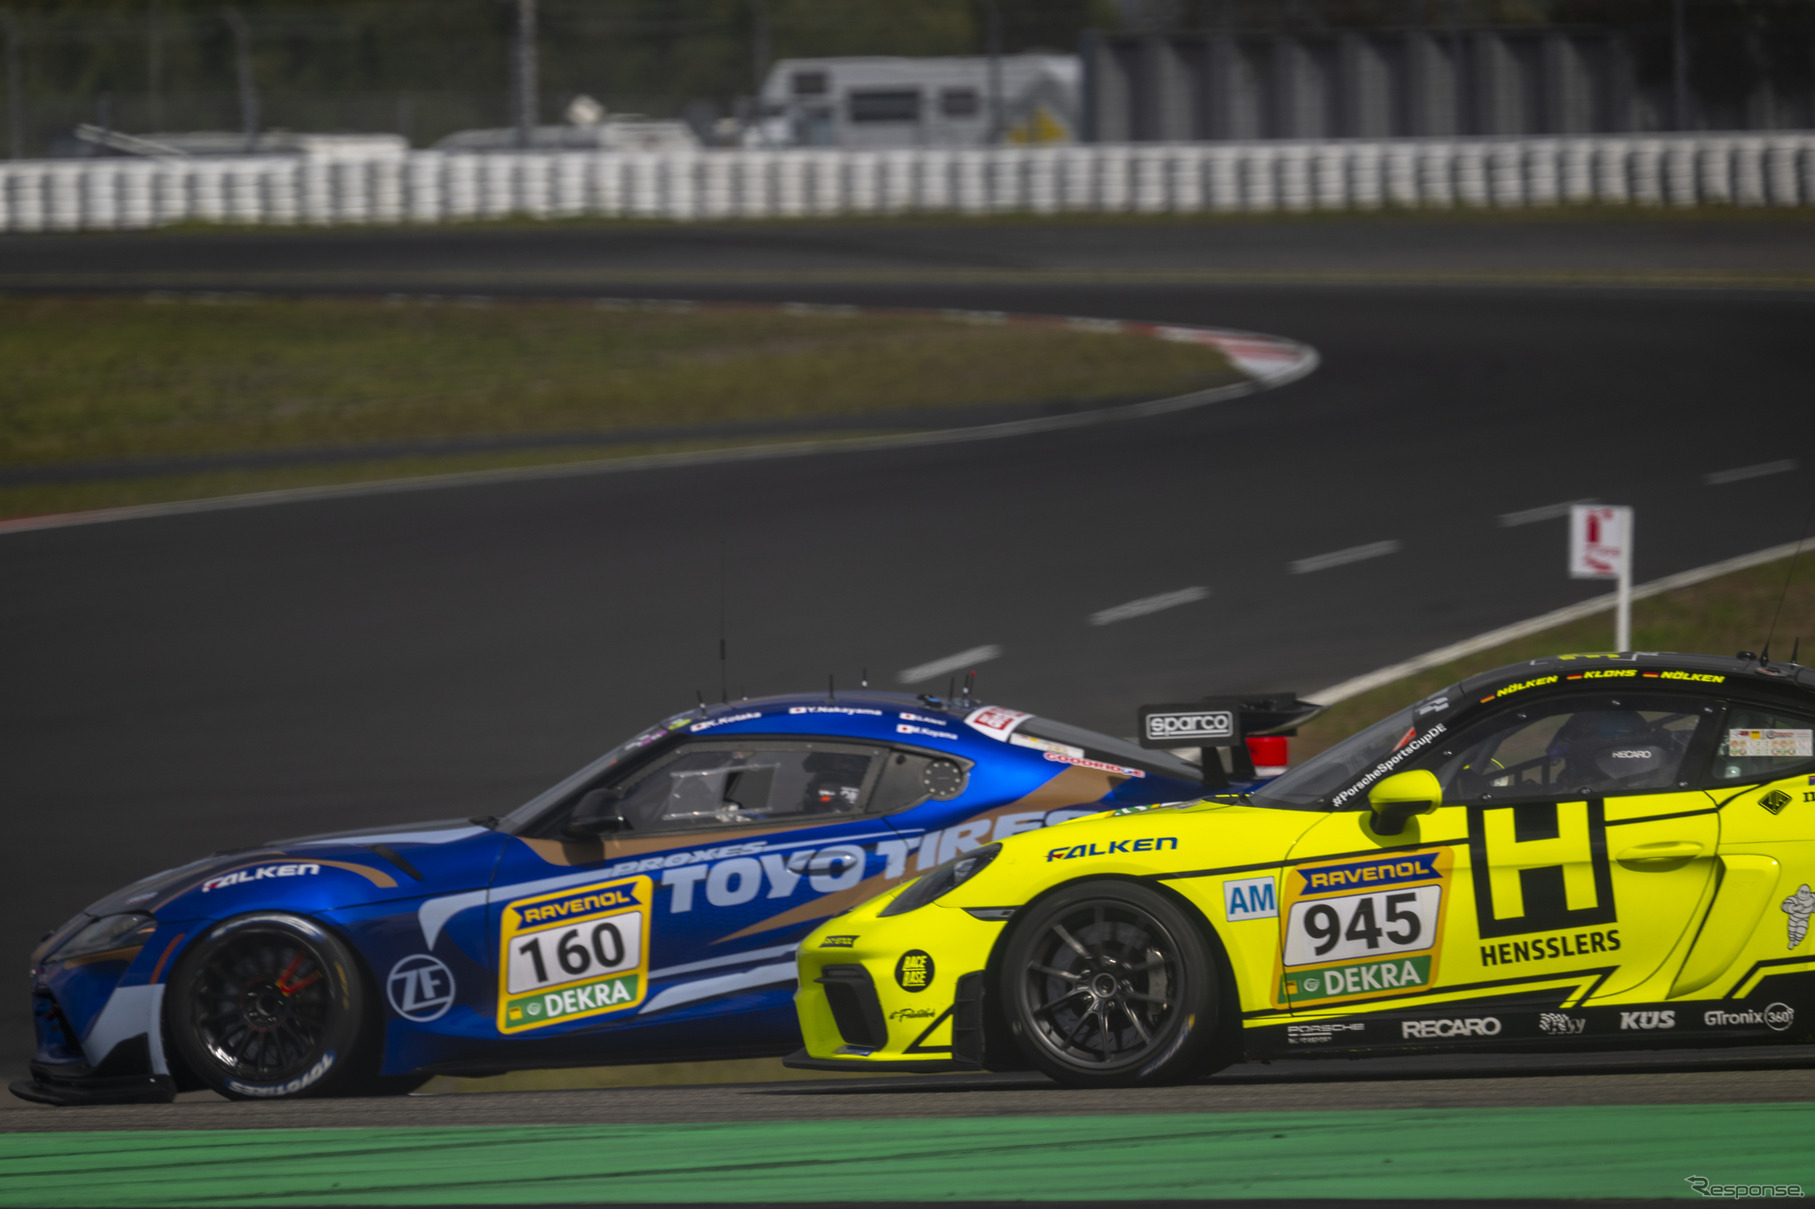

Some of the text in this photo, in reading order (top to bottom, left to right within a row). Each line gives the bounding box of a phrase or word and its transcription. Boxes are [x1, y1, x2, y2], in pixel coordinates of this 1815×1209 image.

[1497, 675, 1558, 697] NÖLKEN
[1660, 671, 1726, 683] NÖLKEN
[1150, 715, 1228, 735] sparco
[1332, 723, 1447, 807] #PorscheSportsCupDE
[610, 840, 768, 877] PROXES
[1046, 837, 1178, 862] FALKEN
[201, 864, 320, 893] FALKEN
[661, 843, 866, 904] TOYO
[1311, 861, 1430, 888] RAVENOL
[524, 891, 631, 922] RAVENOL
[1229, 883, 1275, 915] AM
[1303, 892, 1421, 956] 945
[518, 922, 625, 983] 160
[1480, 929, 1621, 967] HENSSLERS
[390, 965, 450, 1012] ZF
[1323, 960, 1422, 995] DEKRA
[544, 980, 631, 1017] DEKRA
[1287, 1023, 1365, 1033] PORSCHE
[1402, 1017, 1502, 1039] RECARO
